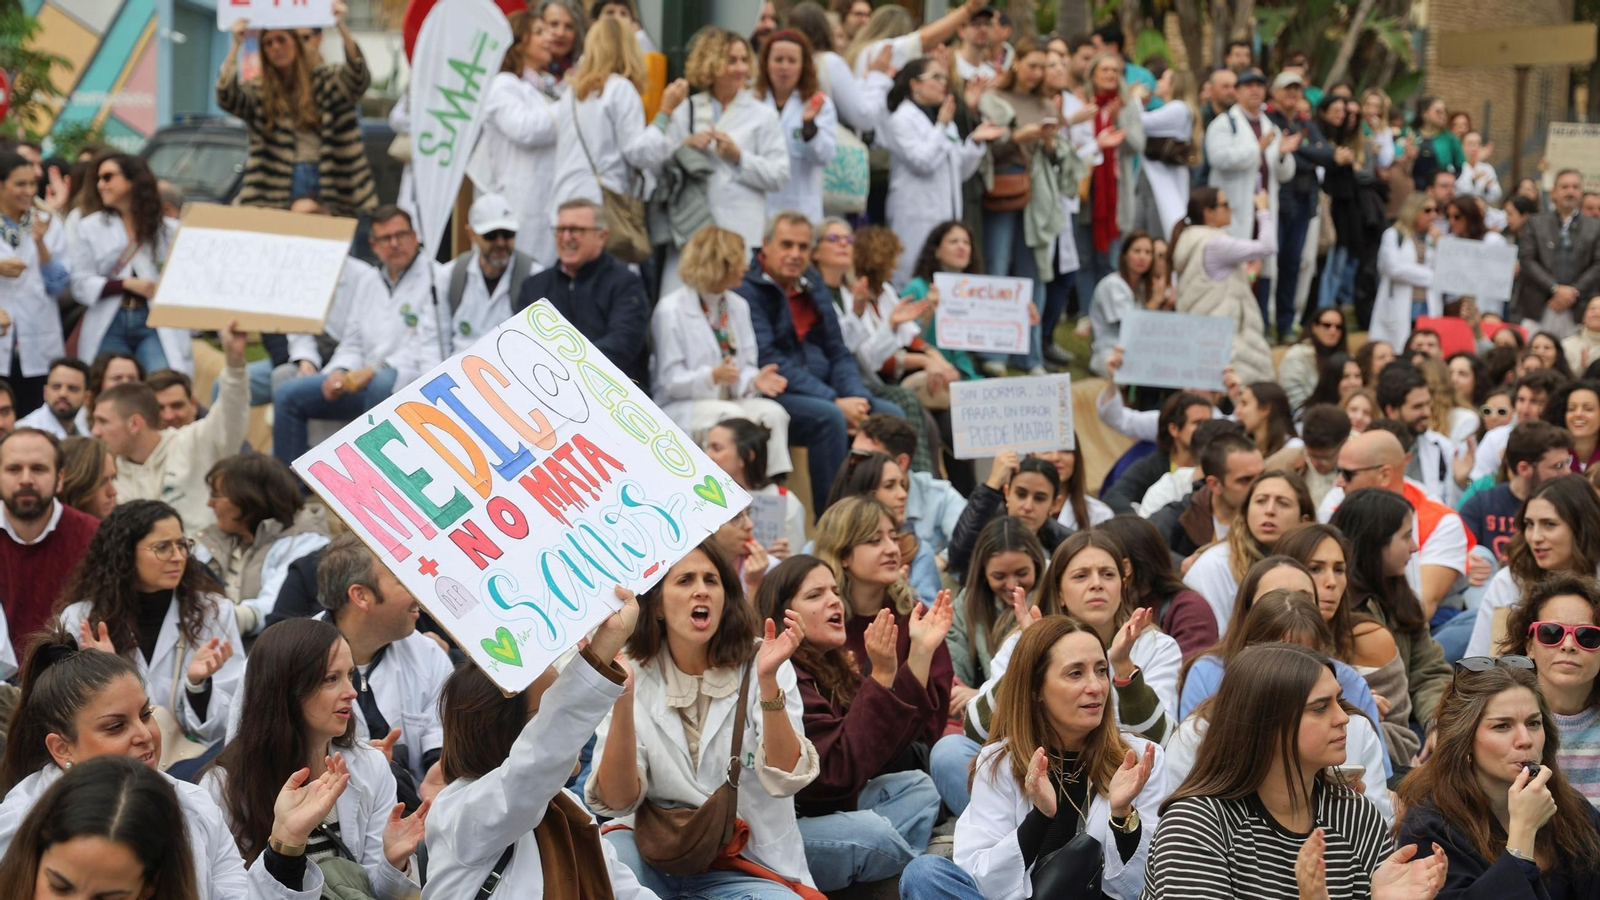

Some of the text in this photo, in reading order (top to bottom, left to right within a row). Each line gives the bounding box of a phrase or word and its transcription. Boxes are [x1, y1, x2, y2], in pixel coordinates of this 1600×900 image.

[418, 33, 488, 167] SMA
[959, 388, 977, 400] SIN
[1036, 384, 1057, 398] SIN
[1003, 405, 1018, 418] UN
[1020, 405, 1051, 418] ERROR
[308, 329, 590, 562] MÉDIC@
[968, 421, 1054, 447] PUEDE MATAR
[448, 433, 625, 571] NO MATA
[441, 584, 468, 611] DEP
